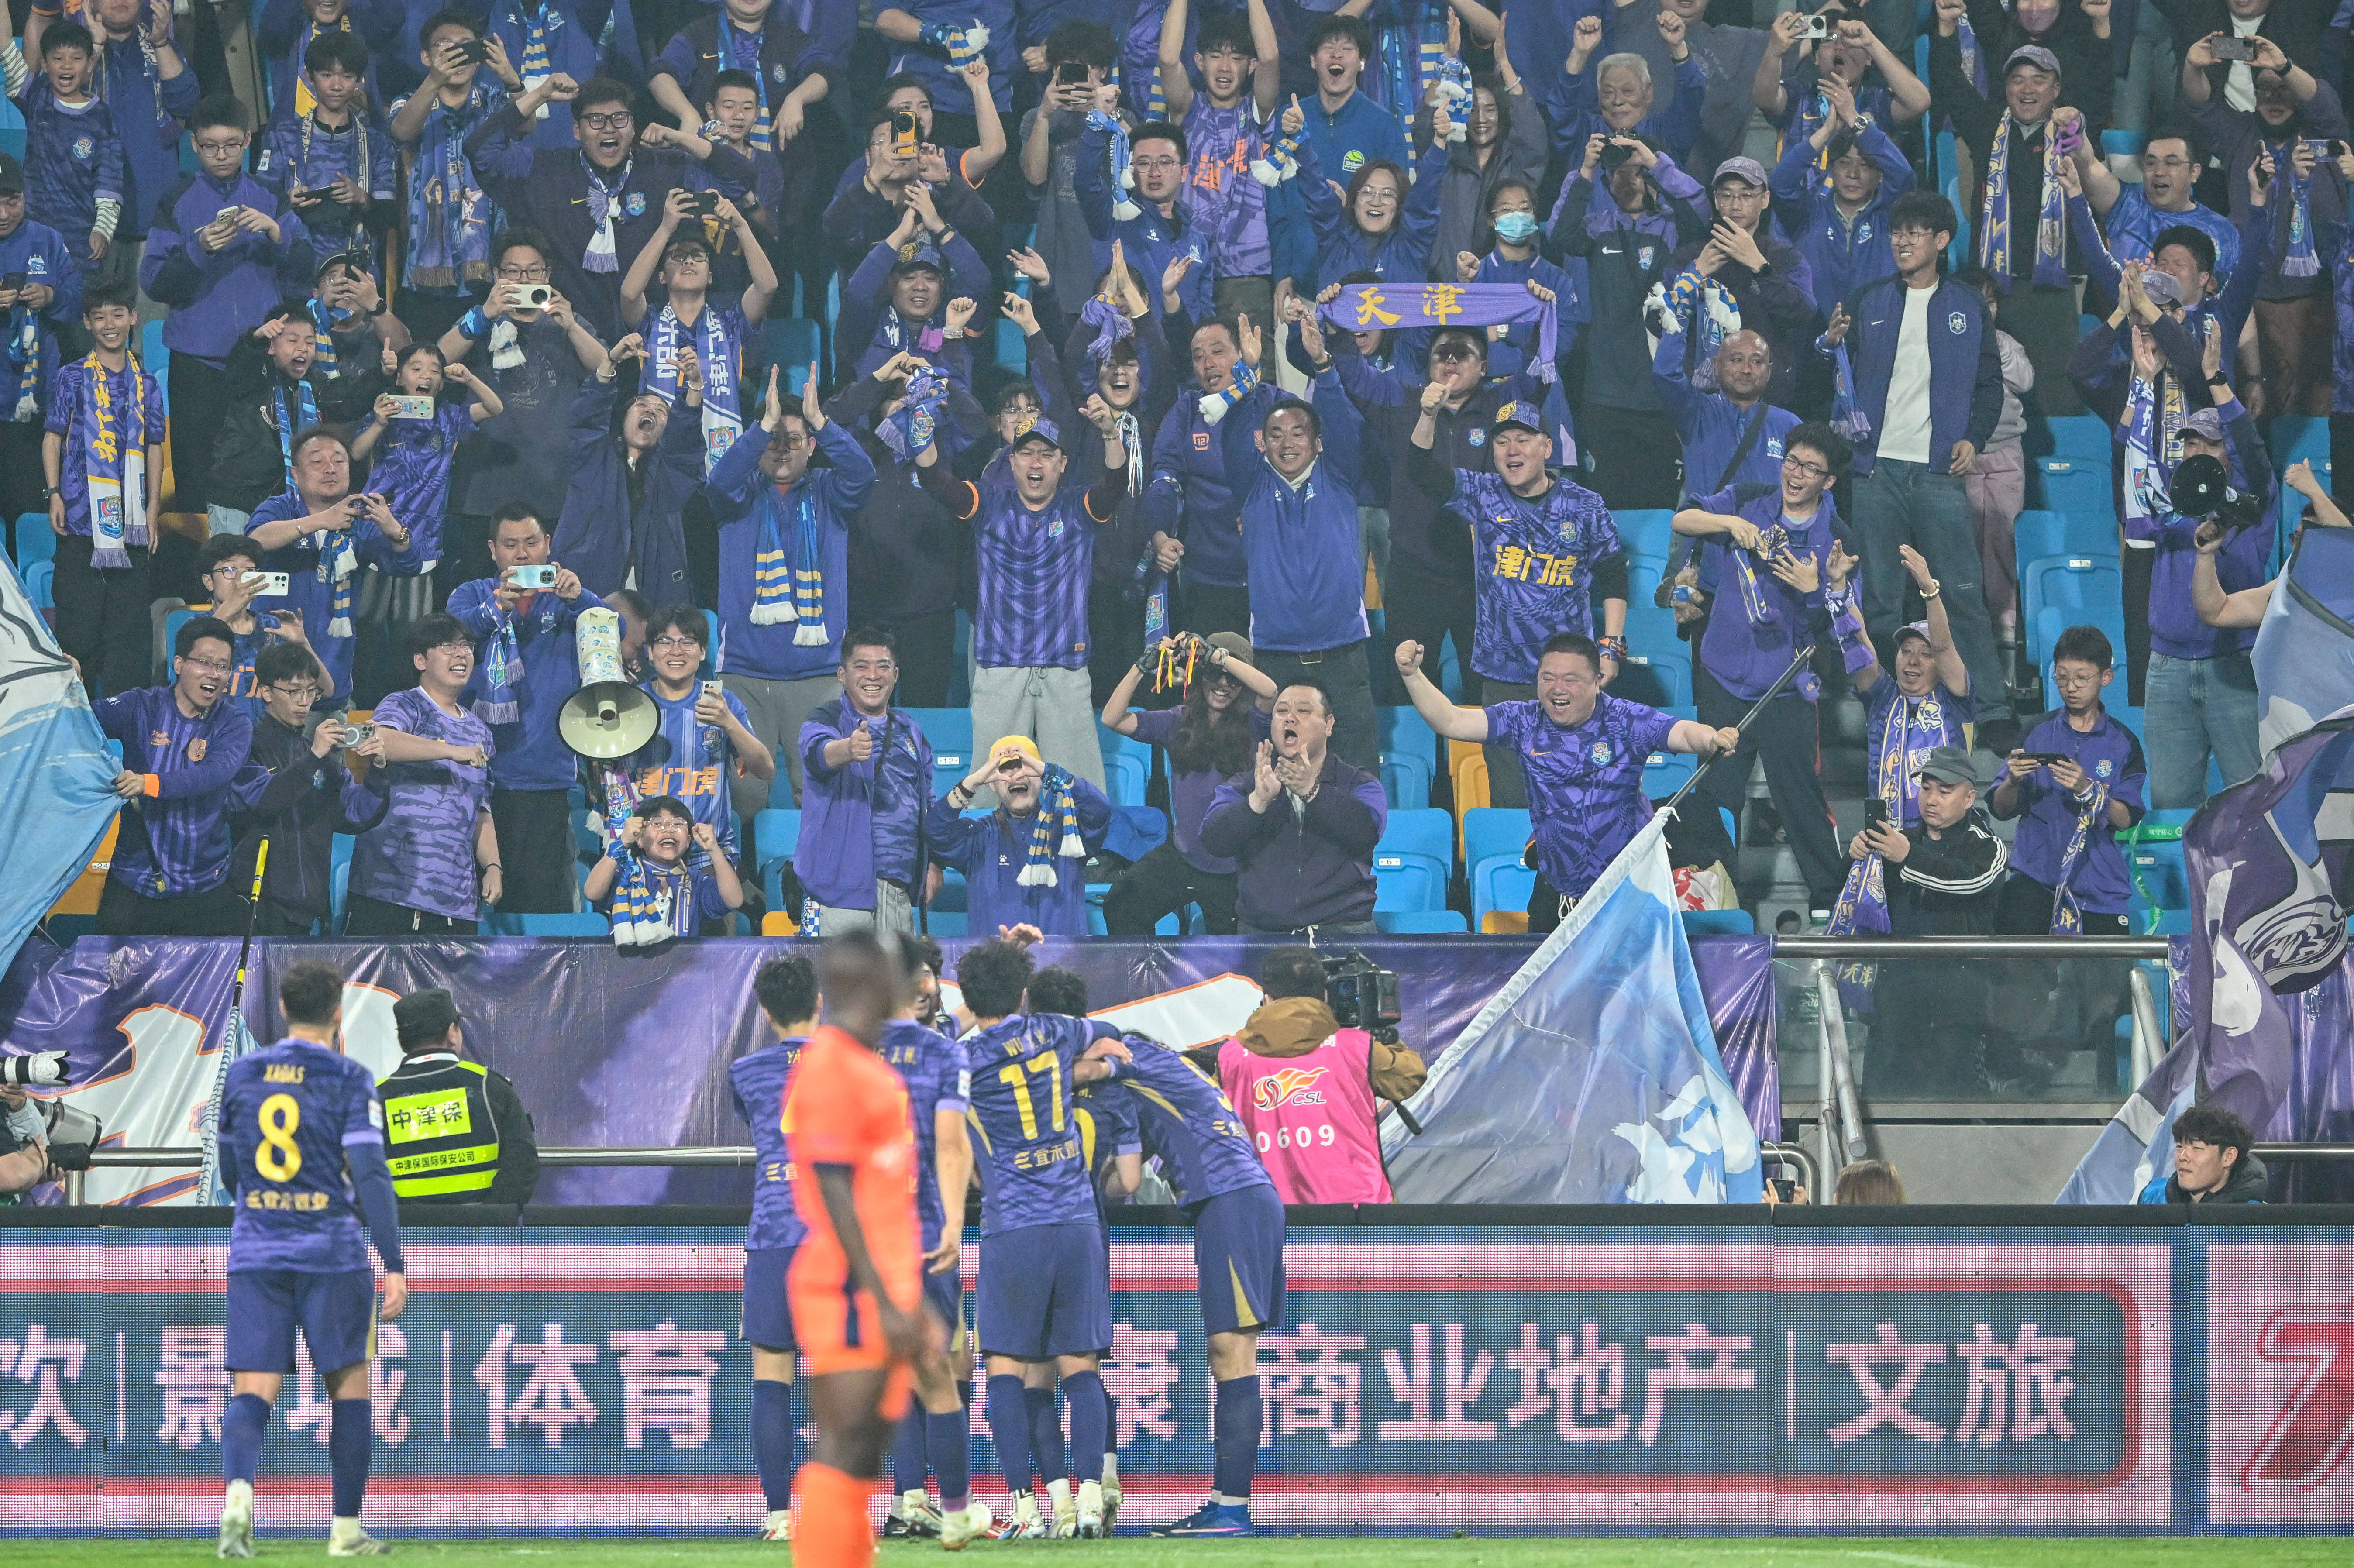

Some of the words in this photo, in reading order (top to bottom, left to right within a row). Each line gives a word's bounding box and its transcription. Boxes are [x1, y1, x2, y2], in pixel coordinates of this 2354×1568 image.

[1357, 285, 1466, 326] 天津
[1197, 437, 1205, 446] 12
[1492, 545, 1578, 586] 津门虎
[998, 1050, 1065, 1141] 17
[1291, 1091, 1326, 1105] CSL
[392, 1101, 464, 1130] 中津保
[255, 1093, 302, 1183] 8
[1255, 1124, 1335, 1153] 0609
[395, 1151, 475, 1172] 中津保国际保安公司
[474, 1318, 727, 1450] 体育
[1256, 1321, 1756, 1448] 商业地产
[1826, 1323, 2078, 1448] 文旅
